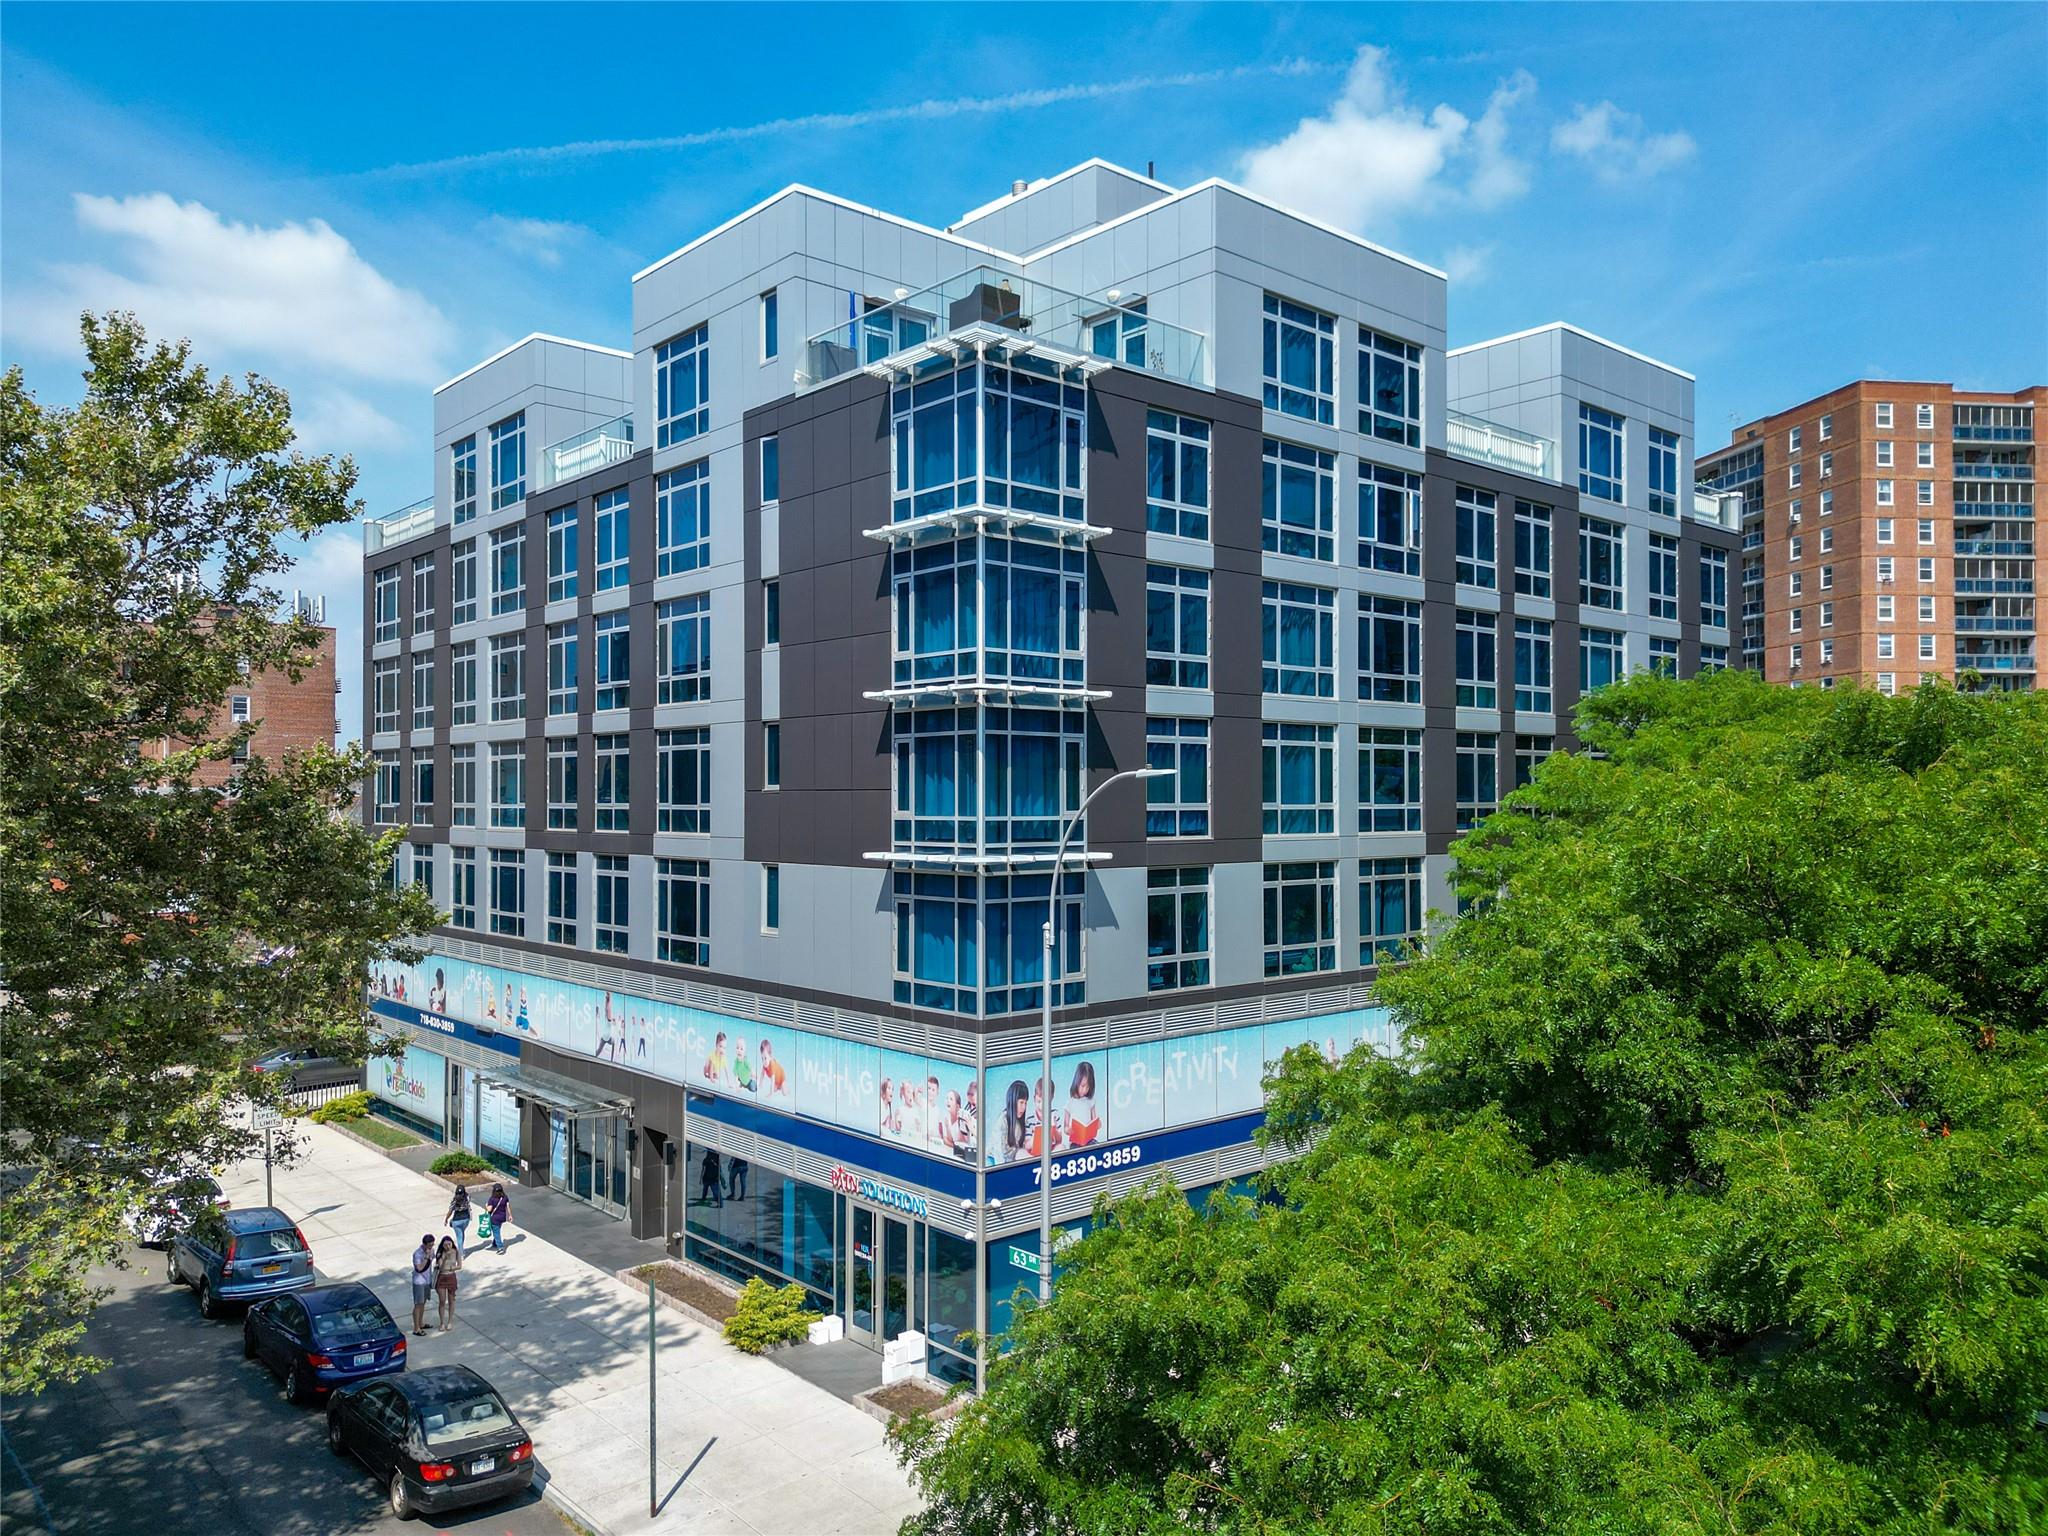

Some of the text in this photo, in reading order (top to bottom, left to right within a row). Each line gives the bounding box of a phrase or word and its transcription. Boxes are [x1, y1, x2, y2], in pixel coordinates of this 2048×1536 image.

[419, 1012, 455, 1033] 718-830-3859
[534, 993, 592, 1031] ATHLETICS
[645, 1015, 706, 1057] SCIENCE
[802, 1057, 874, 1107] WRITING
[1113, 1045, 1239, 1109] CREATIVITY
[1032, 1145, 1141, 1185] 78-830-3859
[831, 1164, 929, 1217] PAIN SOLUTIONS
[1013, 1250, 1037, 1266] 63 DR
